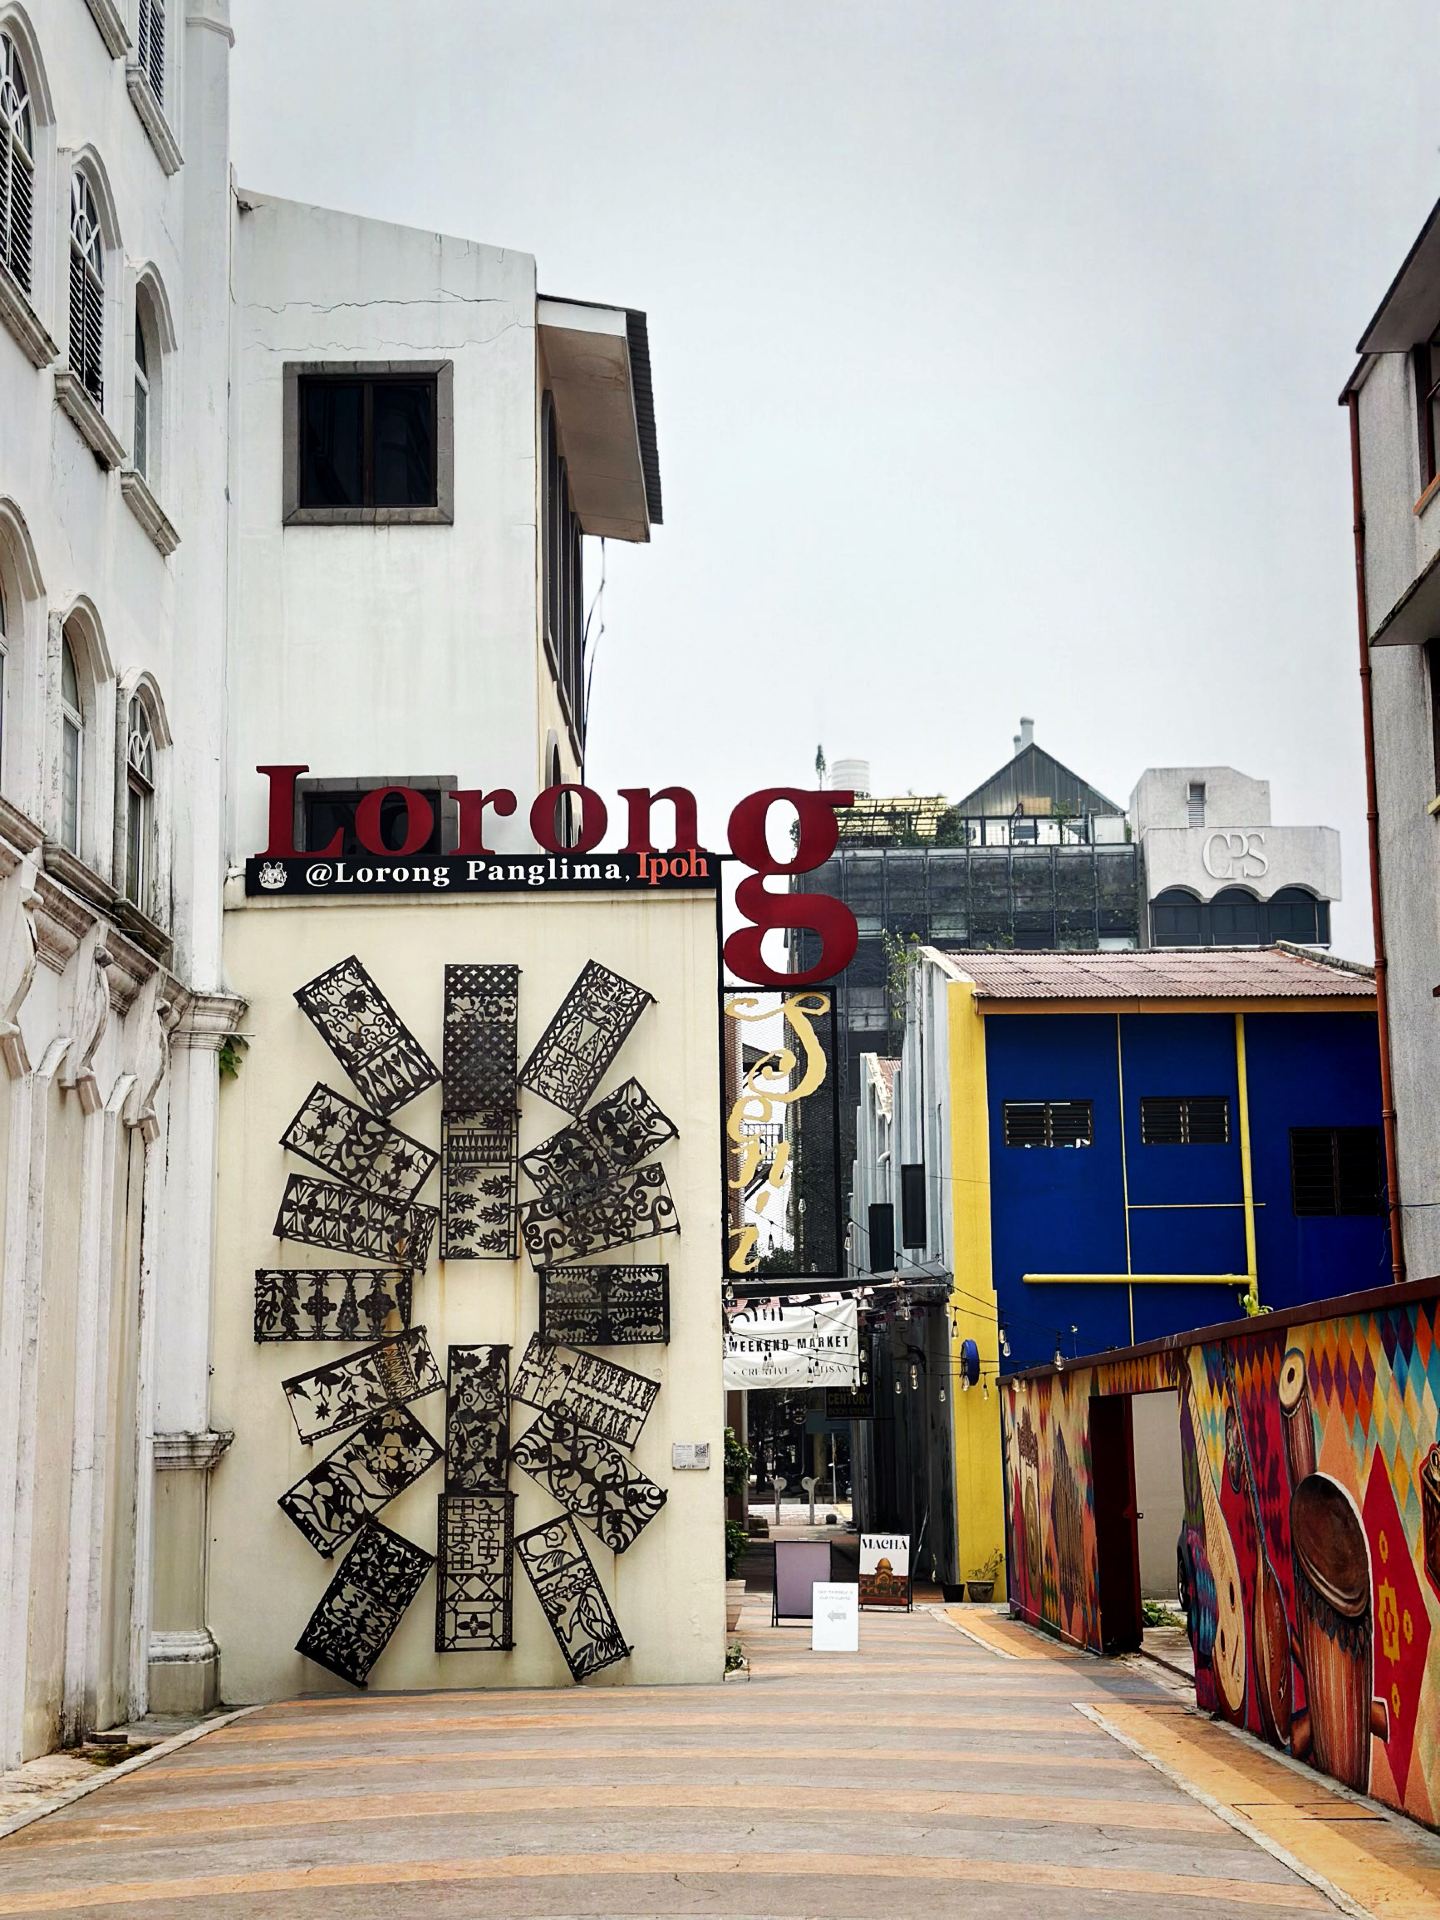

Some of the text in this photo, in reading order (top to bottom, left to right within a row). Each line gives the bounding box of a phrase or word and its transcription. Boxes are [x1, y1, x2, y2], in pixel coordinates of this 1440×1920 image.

[256, 765, 858, 986] Lorong
[306, 849, 710, 887] @Lorong Panglima, Ipoh
[1203, 833, 1269, 879] CPS
[729, 1336, 849, 1352] WEEKEND MARKET
